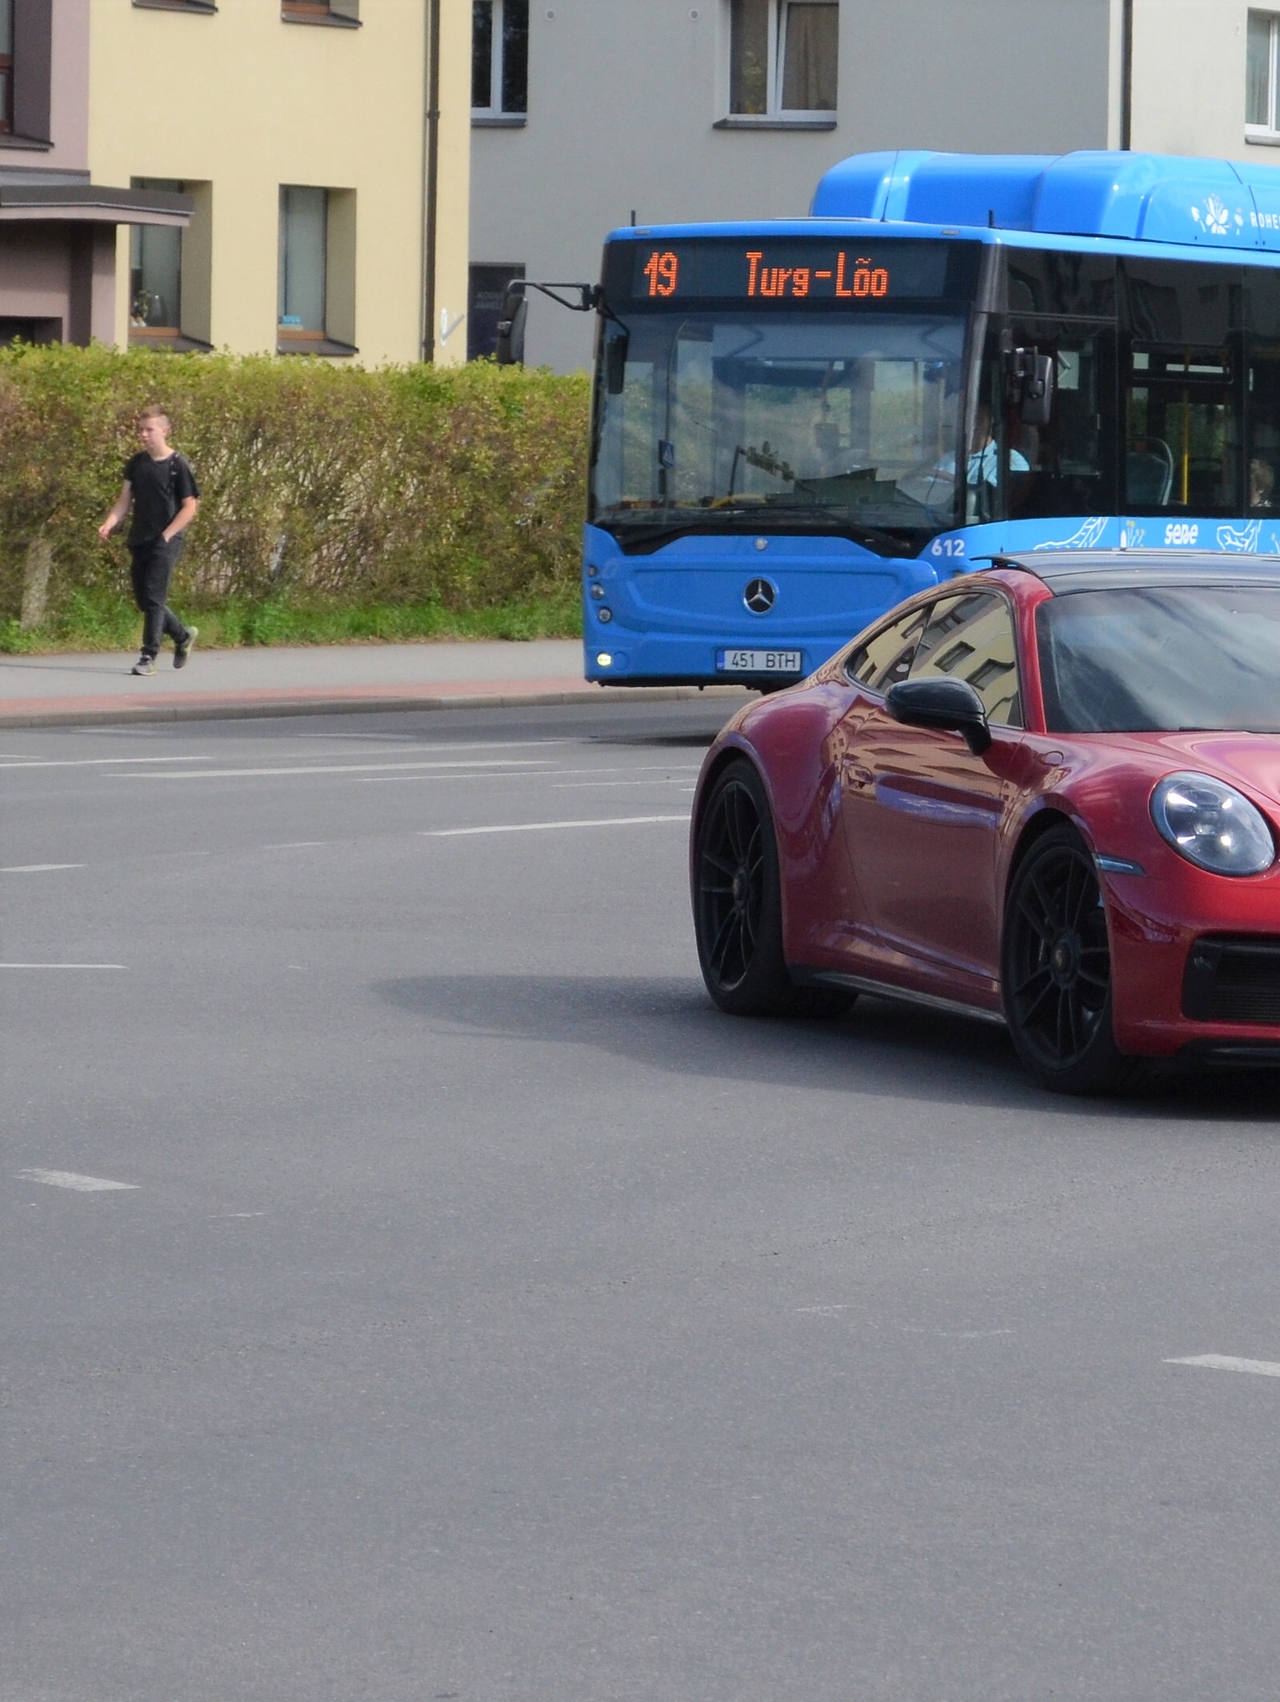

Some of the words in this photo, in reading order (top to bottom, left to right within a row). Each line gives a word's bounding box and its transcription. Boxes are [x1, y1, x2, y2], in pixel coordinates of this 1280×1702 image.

[644, 252, 678, 296] 19
[746, 252, 888, 296] Turg-Lõo
[931, 539, 965, 557] 612
[731, 653, 755, 668] 451
[765, 653, 796, 668] BTH
